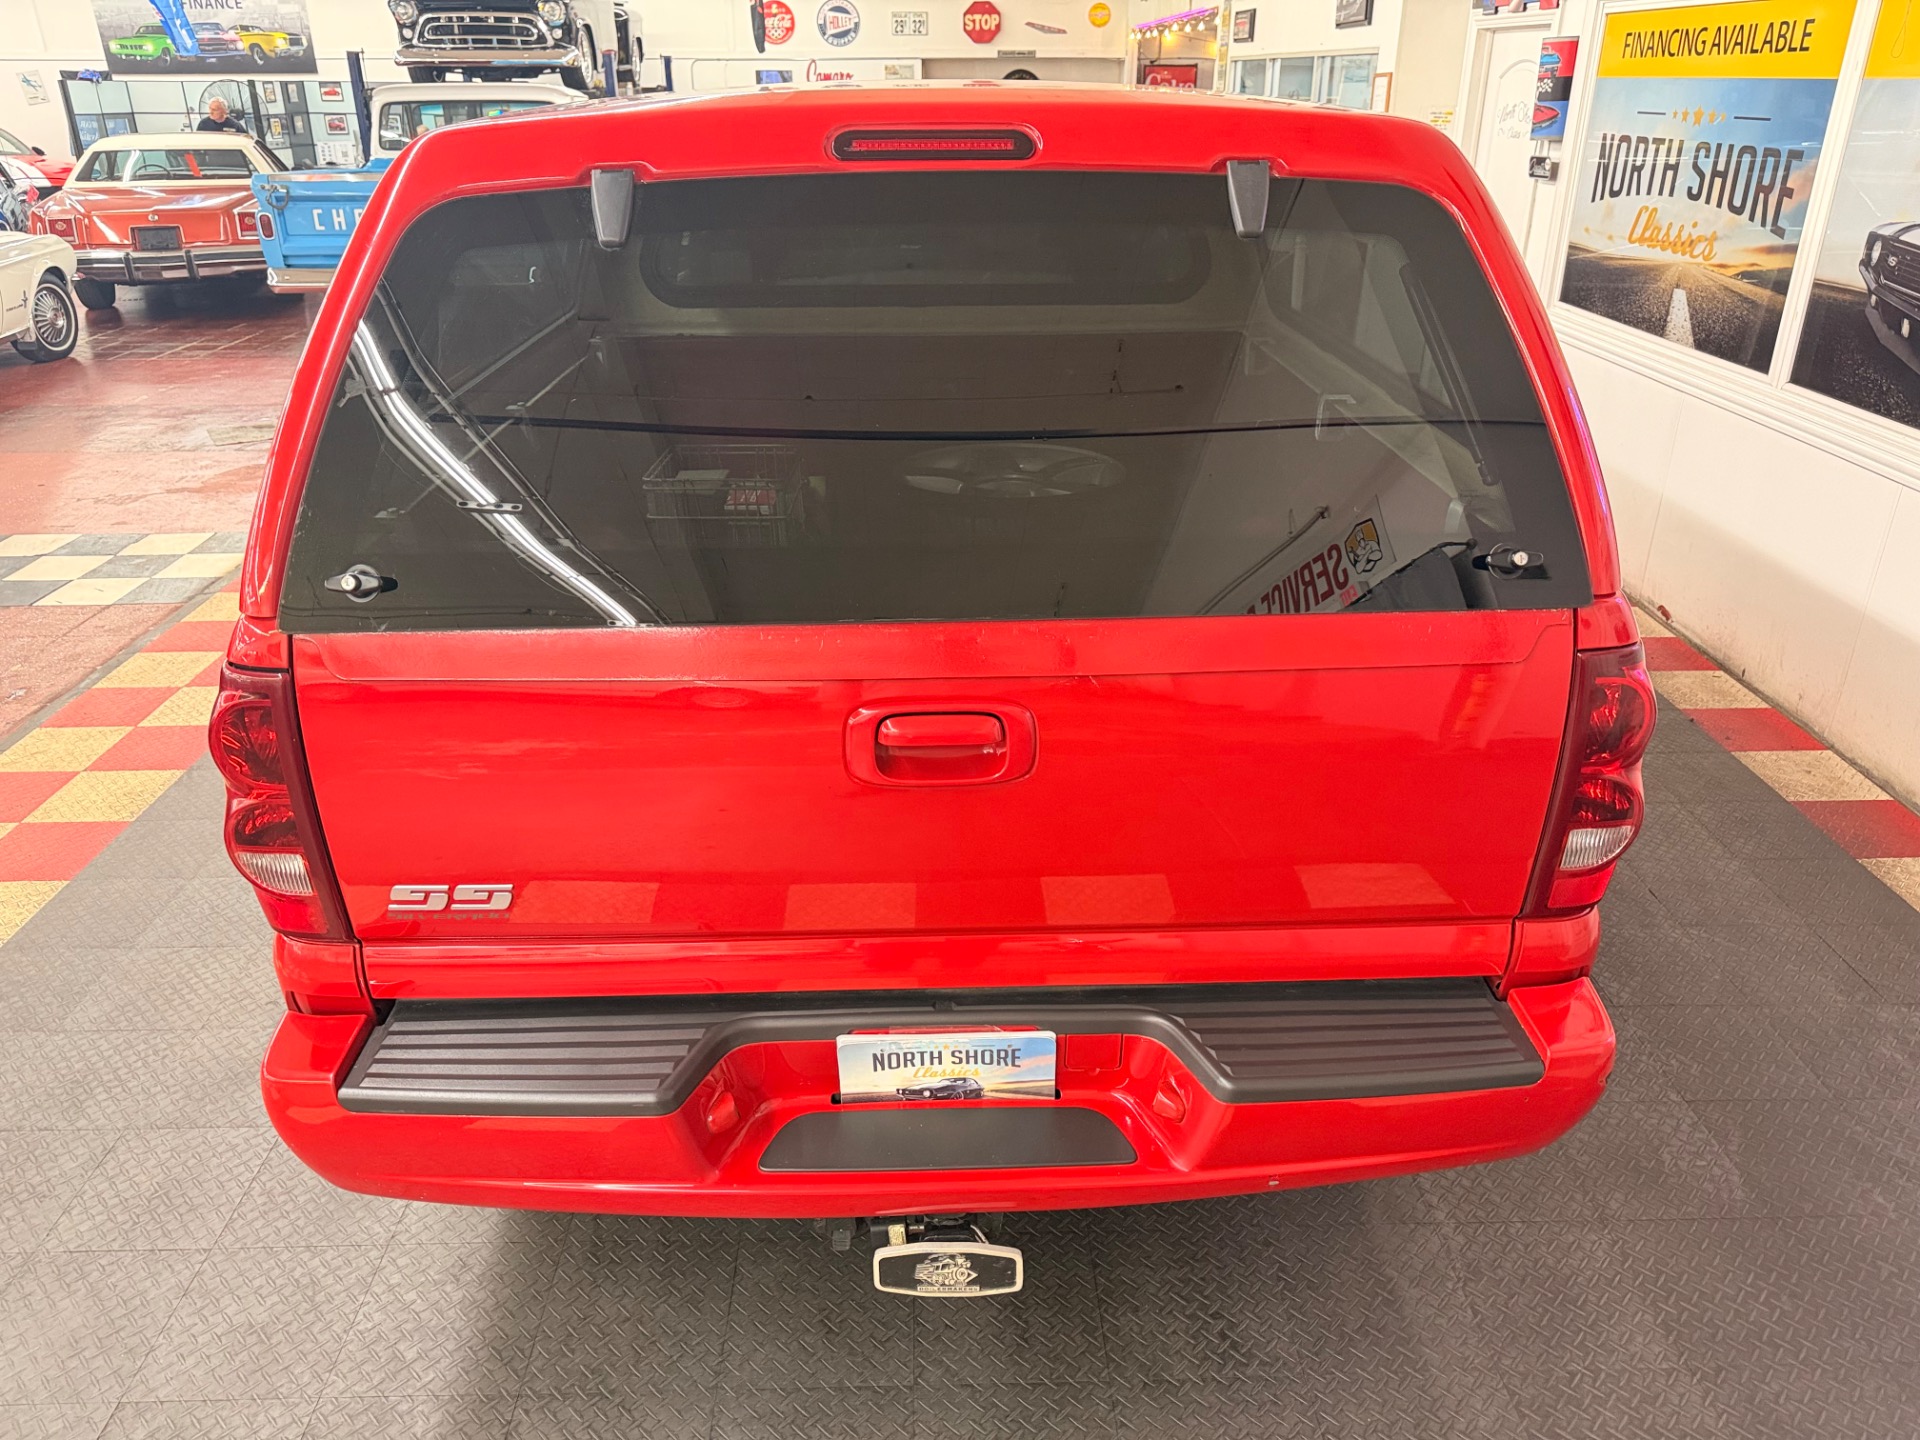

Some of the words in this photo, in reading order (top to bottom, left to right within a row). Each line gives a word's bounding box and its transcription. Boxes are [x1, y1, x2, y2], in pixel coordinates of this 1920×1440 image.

[182, 0, 243, 10] FINANCE
[828, 15, 852, 31] HOLLEY
[964, 13, 1000, 31] STOP
[1622, 28, 1707, 58] FINANCING
[1708, 18, 1816, 56] AVAILABLE
[806, 58, 854, 82] Camaro
[1591, 132, 1685, 204] NORTH
[1686, 141, 1805, 241] SHORE
[1627, 205, 1718, 262] Classics
[387, 883, 514, 911] SS
[871, 1049, 943, 1072] NORTH
[950, 1047, 1022, 1068] SHORE
[912, 1065, 981, 1079] Classics
